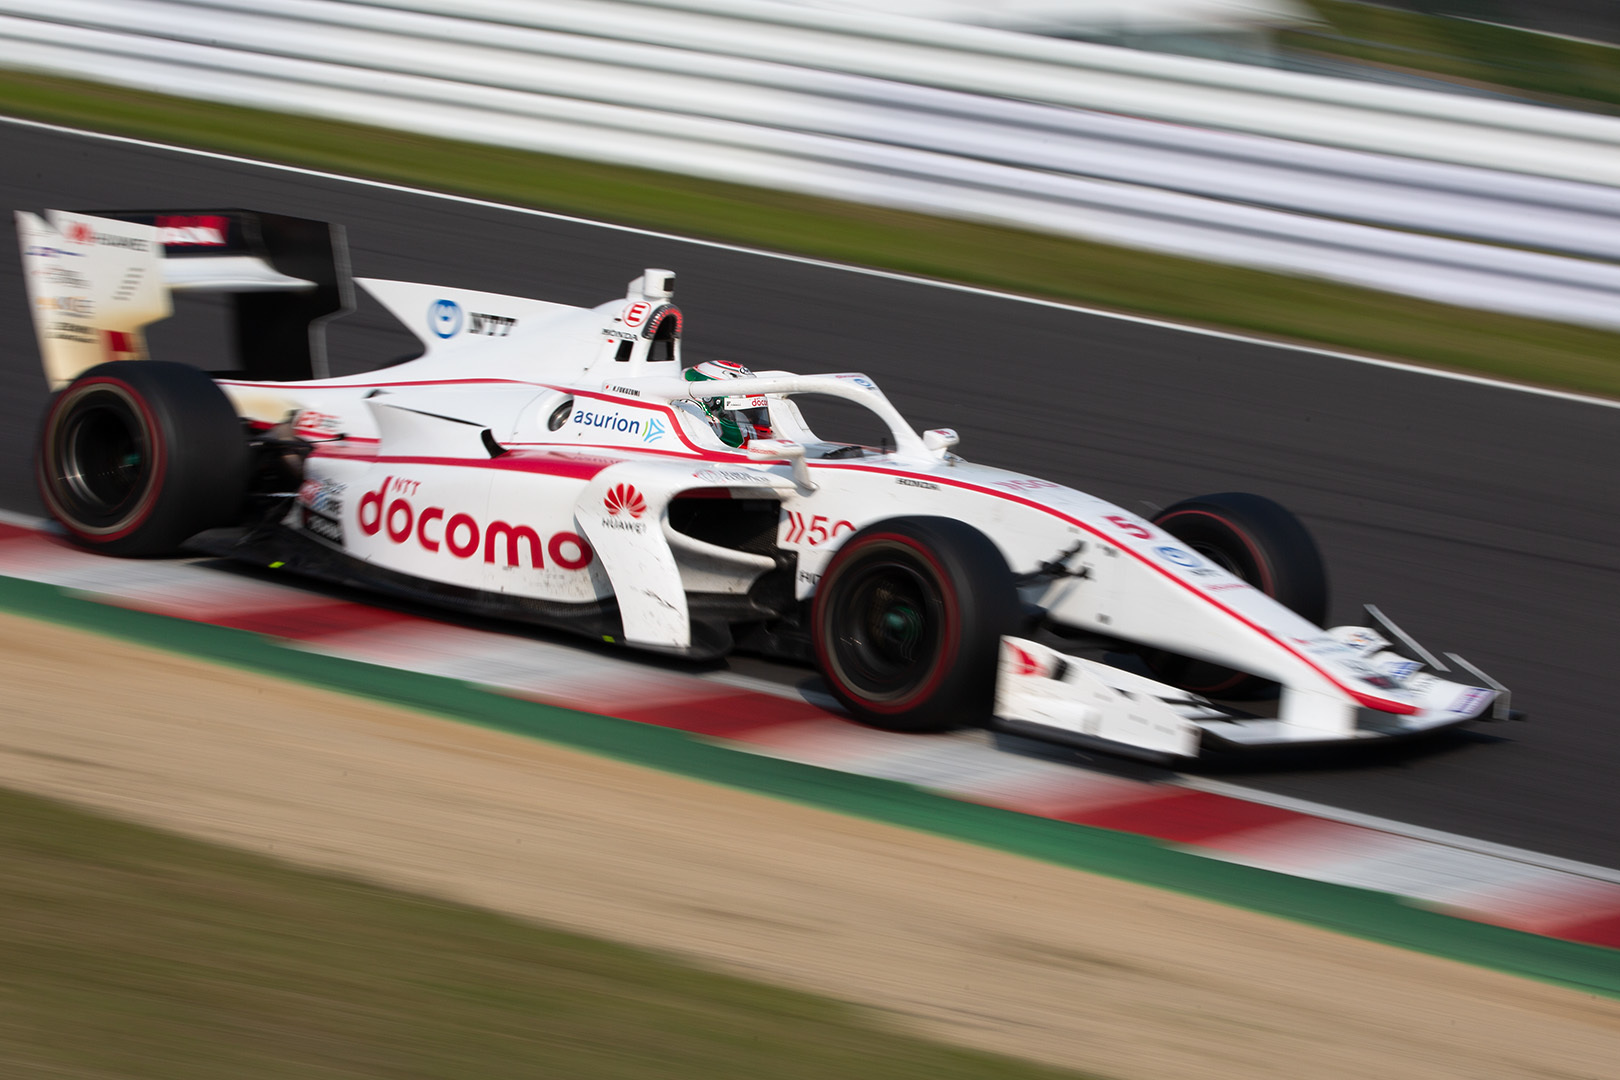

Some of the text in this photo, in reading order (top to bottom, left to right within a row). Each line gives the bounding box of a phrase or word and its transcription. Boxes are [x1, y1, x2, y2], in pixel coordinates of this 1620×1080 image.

[627, 303, 647, 322] E
[468, 311, 518, 336] NTT
[602, 328, 638, 341] HONDA
[573, 409, 640, 434] asurion
[392, 477, 421, 496] NTT
[358, 475, 594, 570] docomo
[602, 516, 647, 535] HUAWEI
